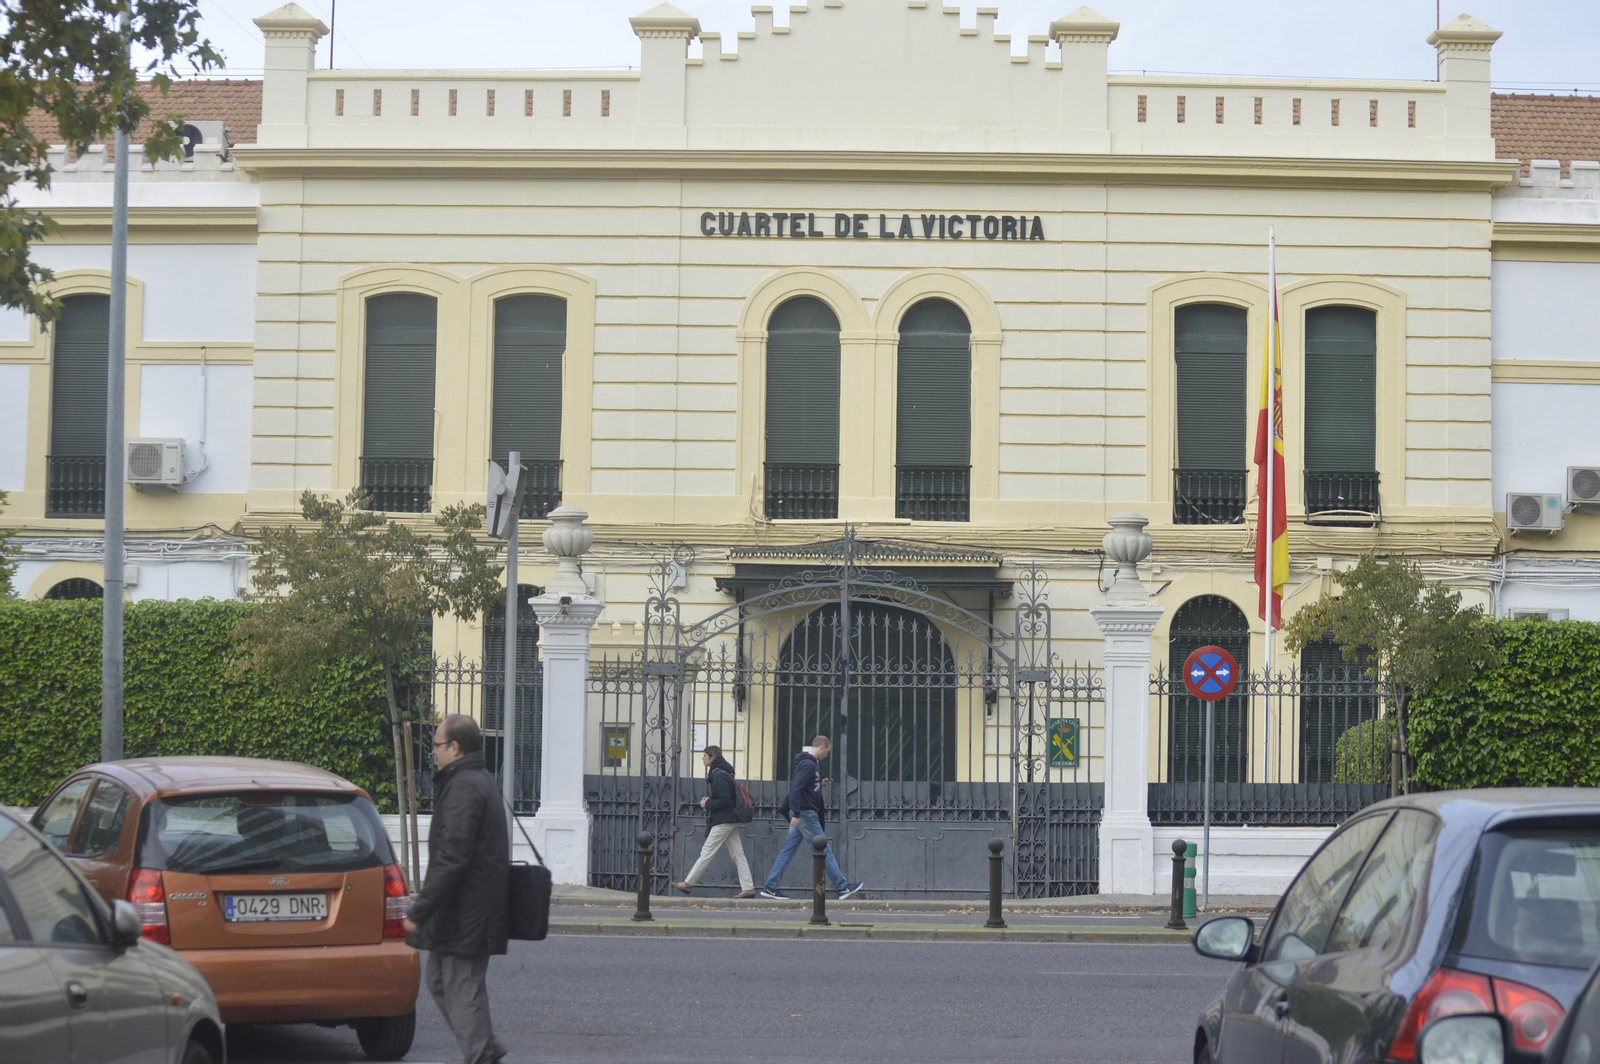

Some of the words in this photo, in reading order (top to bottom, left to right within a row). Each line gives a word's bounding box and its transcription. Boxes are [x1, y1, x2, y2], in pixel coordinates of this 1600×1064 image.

[700, 211, 823, 237] CUARTEL
[835, 213, 868, 238] DE
[879, 214, 913, 238] LA
[921, 214, 1044, 240] VICTORIA
[1050, 719, 1068, 729] GUARIA
[237, 898, 280, 915] 0429
[289, 897, 321, 914] DNR
